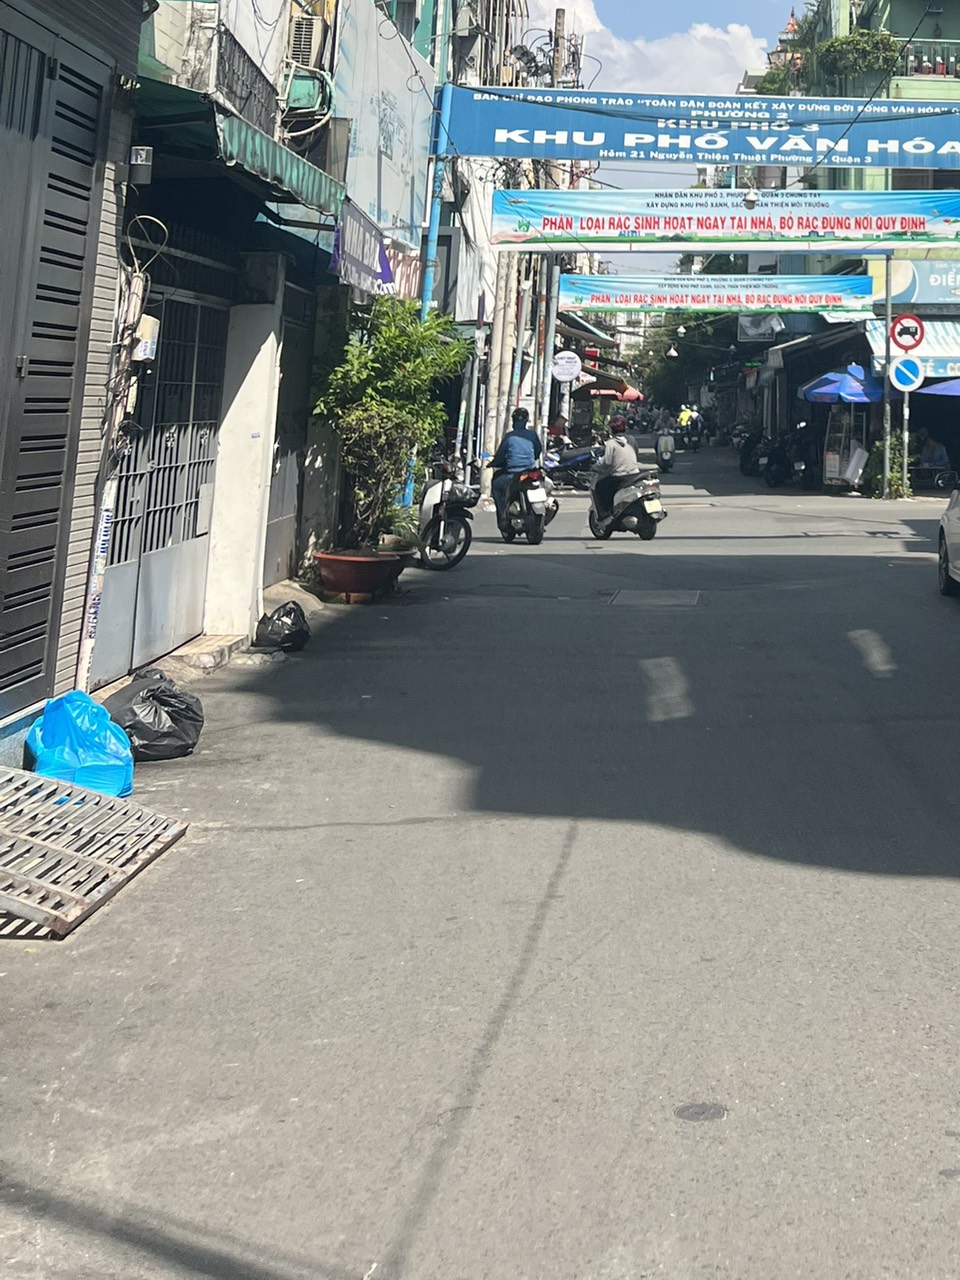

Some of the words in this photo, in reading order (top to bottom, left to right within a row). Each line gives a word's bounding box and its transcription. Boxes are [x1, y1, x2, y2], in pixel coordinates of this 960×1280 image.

[473, 93, 499, 101] BAN
[527, 95, 553, 104] ĐẠO
[556, 96, 597, 105] PHONG
[600, 96, 633, 106] TRÀO
[680, 98, 705, 108] DÂN
[708, 99, 741, 110] ĐOÀN
[744, 100, 768, 110] KẾT
[771, 101, 795, 111] XÂY
[798, 103, 831, 113] DỰNG
[833, 103, 855, 112] ĐỜI
[857, 102, 888, 113] SỐNG
[891, 105, 915, 113] VĂN
[691, 109, 770, 119] PHƯỜNG
[776, 112, 789, 120] 2
[657, 118, 720, 130] KHU
[731, 119, 793, 132] PHỐ
[802, 123, 820, 132] 3
[494, 128, 605, 146] KHU
[623, 130, 730, 149] PHỐ
[745, 134, 849, 152] VĂN
[630, 150, 645, 158] 21
[650, 150, 694, 161] Nguyễn
[697, 152, 729, 162] Thiện
[732, 153, 767, 164] Thuật
[770, 154, 812, 165] Phường
[831, 155, 860, 165] Quận
[864, 156, 872, 164] 3
[704, 191, 718, 199] PHỐ
[804, 201, 830, 209] TRƯỜNG
[542, 213, 573, 231] PHÂN
[579, 216, 605, 234] LOẠI
[608, 213, 631, 231] RÁC
[634, 216, 661, 231] SINH
[663, 216, 695, 234] HOẠT
[697, 216, 726, 231] NGAY
[730, 216, 747, 234] TẠI
[750, 212, 776, 233] NHÀ,
[779, 211, 794, 230] BỎ
[797, 212, 819, 230] RÁC
[821, 212, 851, 231] ĐÚNG
[854, 215, 873, 230] NƠI
[877, 216, 897, 231] QUY
[900, 216, 926, 234] ĐỊNH
[590, 293, 611, 303] PHÂN
[614, 294, 631, 305] LOẠI
[633, 293, 648, 304] RÁC
[650, 294, 667, 304] SINH
[669, 294, 689, 305] HOẠT
[690, 294, 711, 304] NGAY
[713, 294, 725, 305] TẠI
[756, 293, 771, 304] RÁC
[772, 293, 793, 304] ĐÚNG
[794, 293, 807, 304] NƠI
[809, 294, 822, 304] QUY
[825, 294, 842, 306] ĐỊNH
